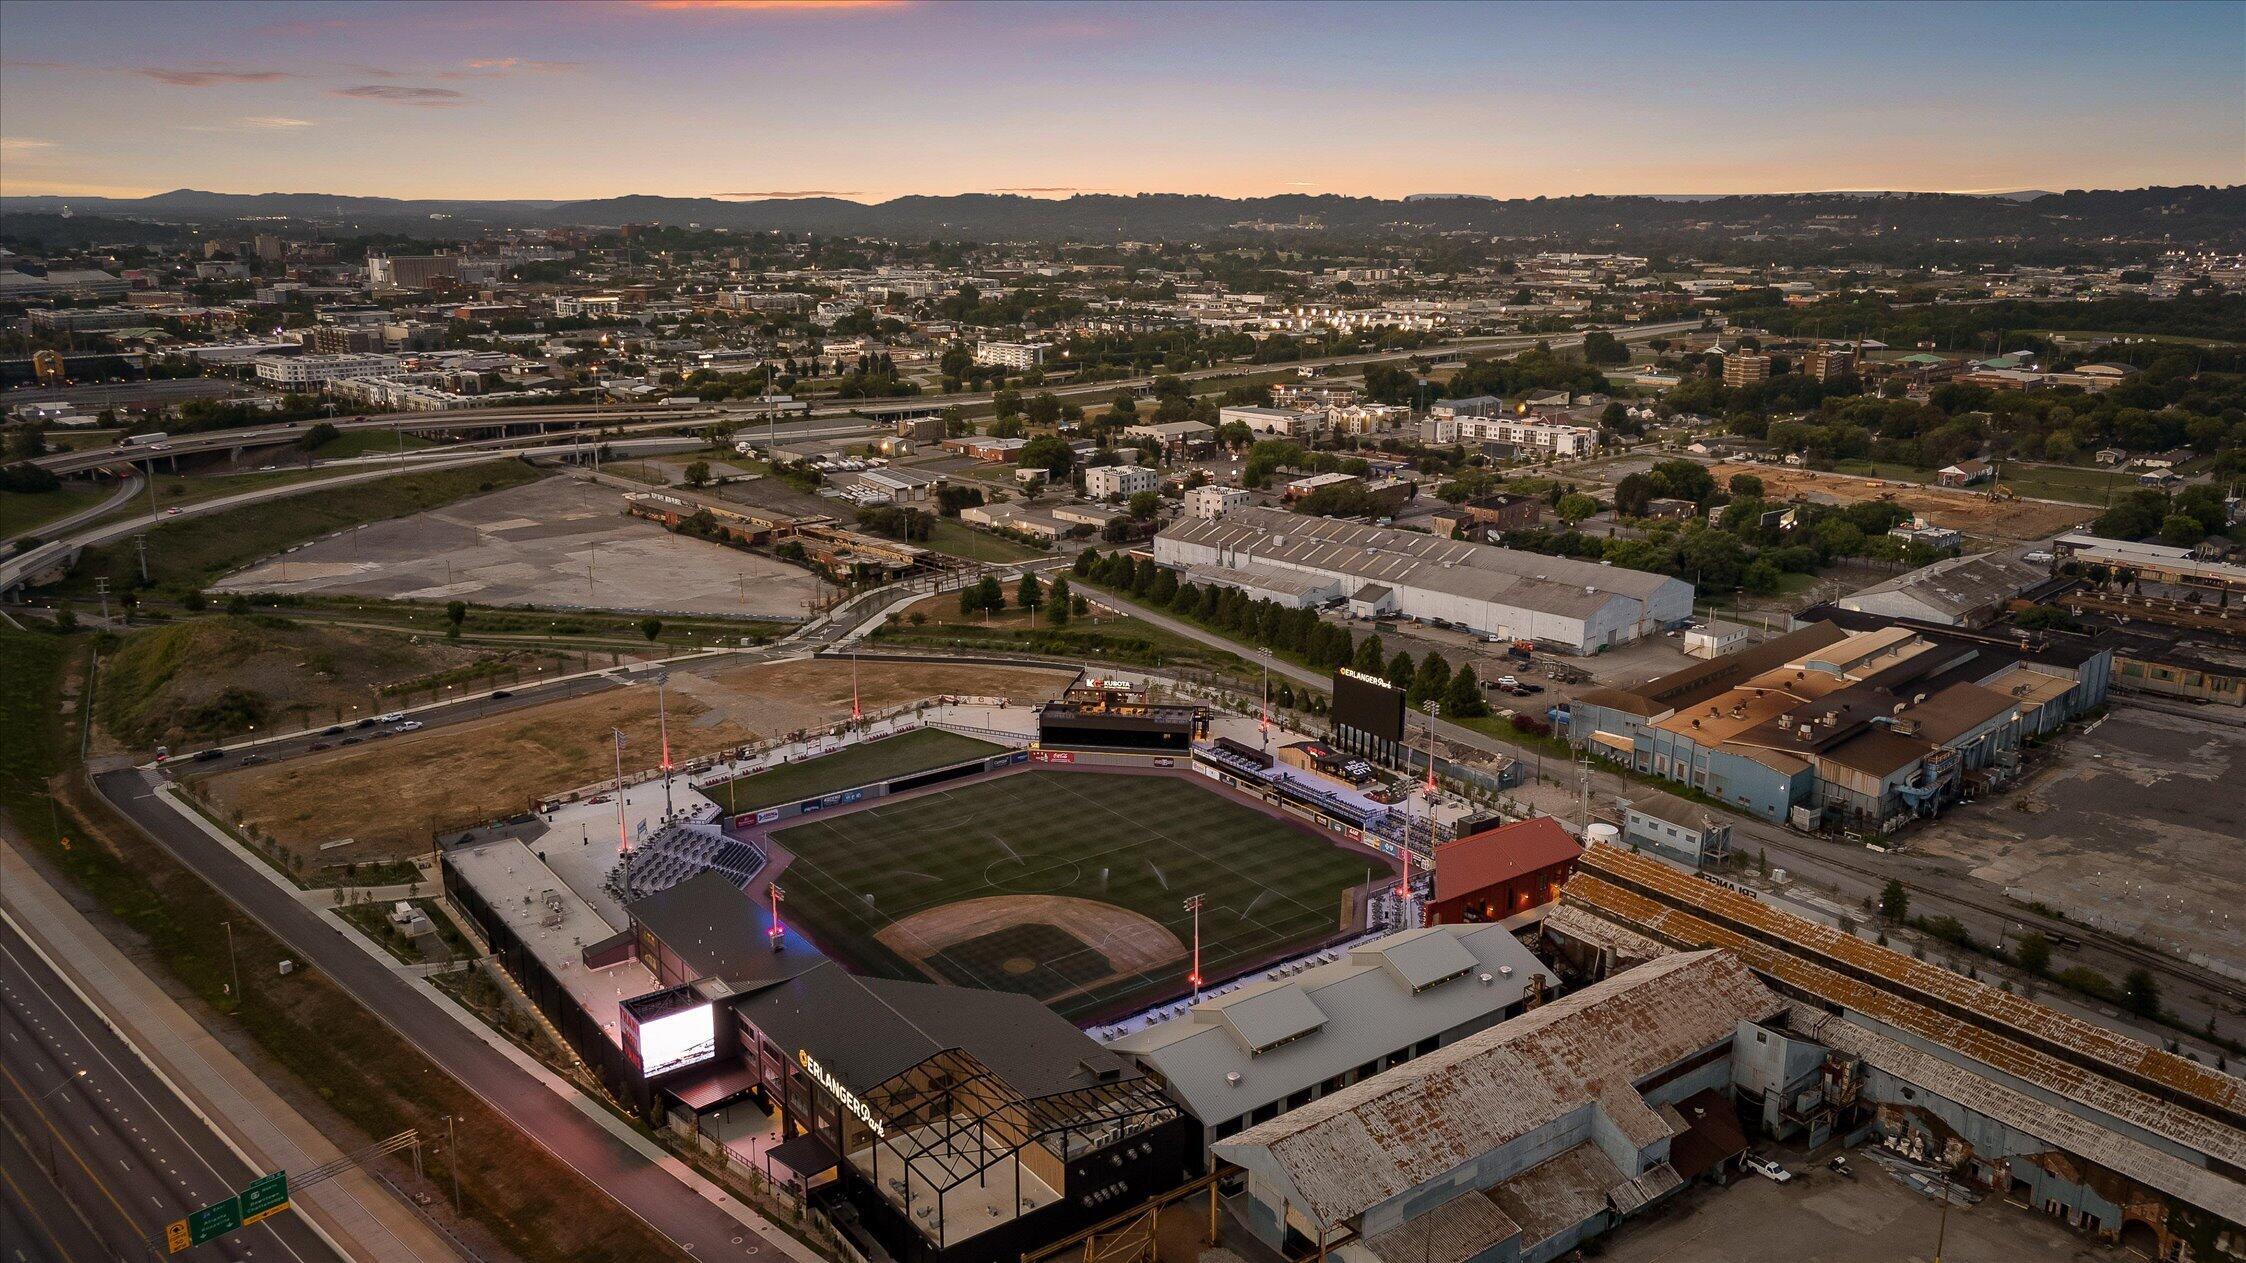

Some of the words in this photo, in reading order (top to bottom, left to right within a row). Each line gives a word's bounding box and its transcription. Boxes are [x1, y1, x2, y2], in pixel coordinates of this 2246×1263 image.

[1345, 669, 1378, 685] ERLANGER
[1104, 680, 1131, 688] KUBOTA
[1345, 761, 1369, 772] ROCK
[1353, 766, 1372, 775] CITY
[807, 1055, 861, 1117] ERLANGER
[860, 1103, 885, 1138] Park
